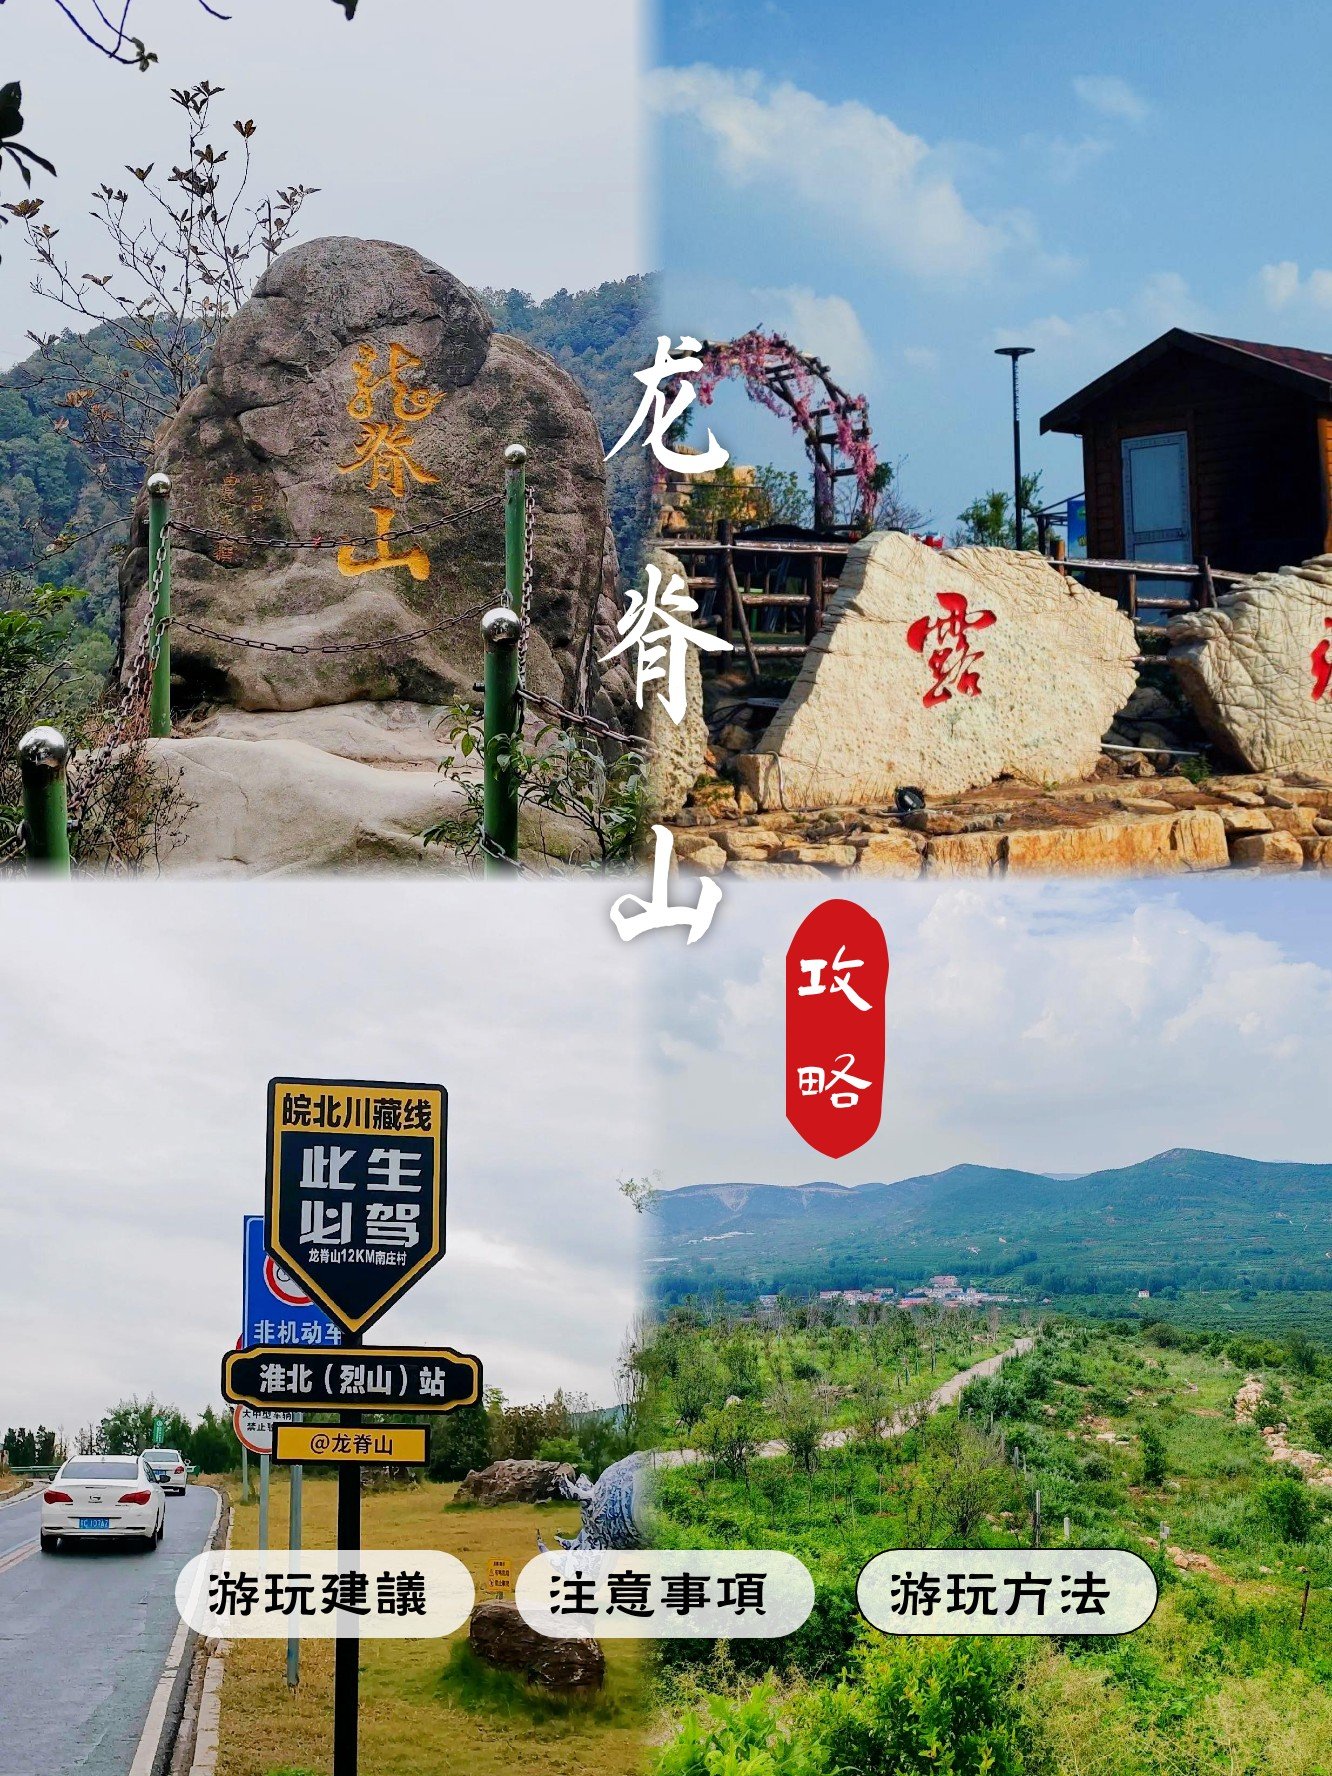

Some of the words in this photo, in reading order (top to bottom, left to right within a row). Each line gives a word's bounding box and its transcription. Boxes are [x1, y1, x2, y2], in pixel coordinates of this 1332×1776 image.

[281, 1092, 433, 1132] 皖北川藏线
[299, 1145, 423, 1193] 此生
[299, 1200, 421, 1248] 必驾
[308, 1248, 408, 1267] 龙脊山12KM南庄村
[310, 1431, 394, 1456] @龙脊山
